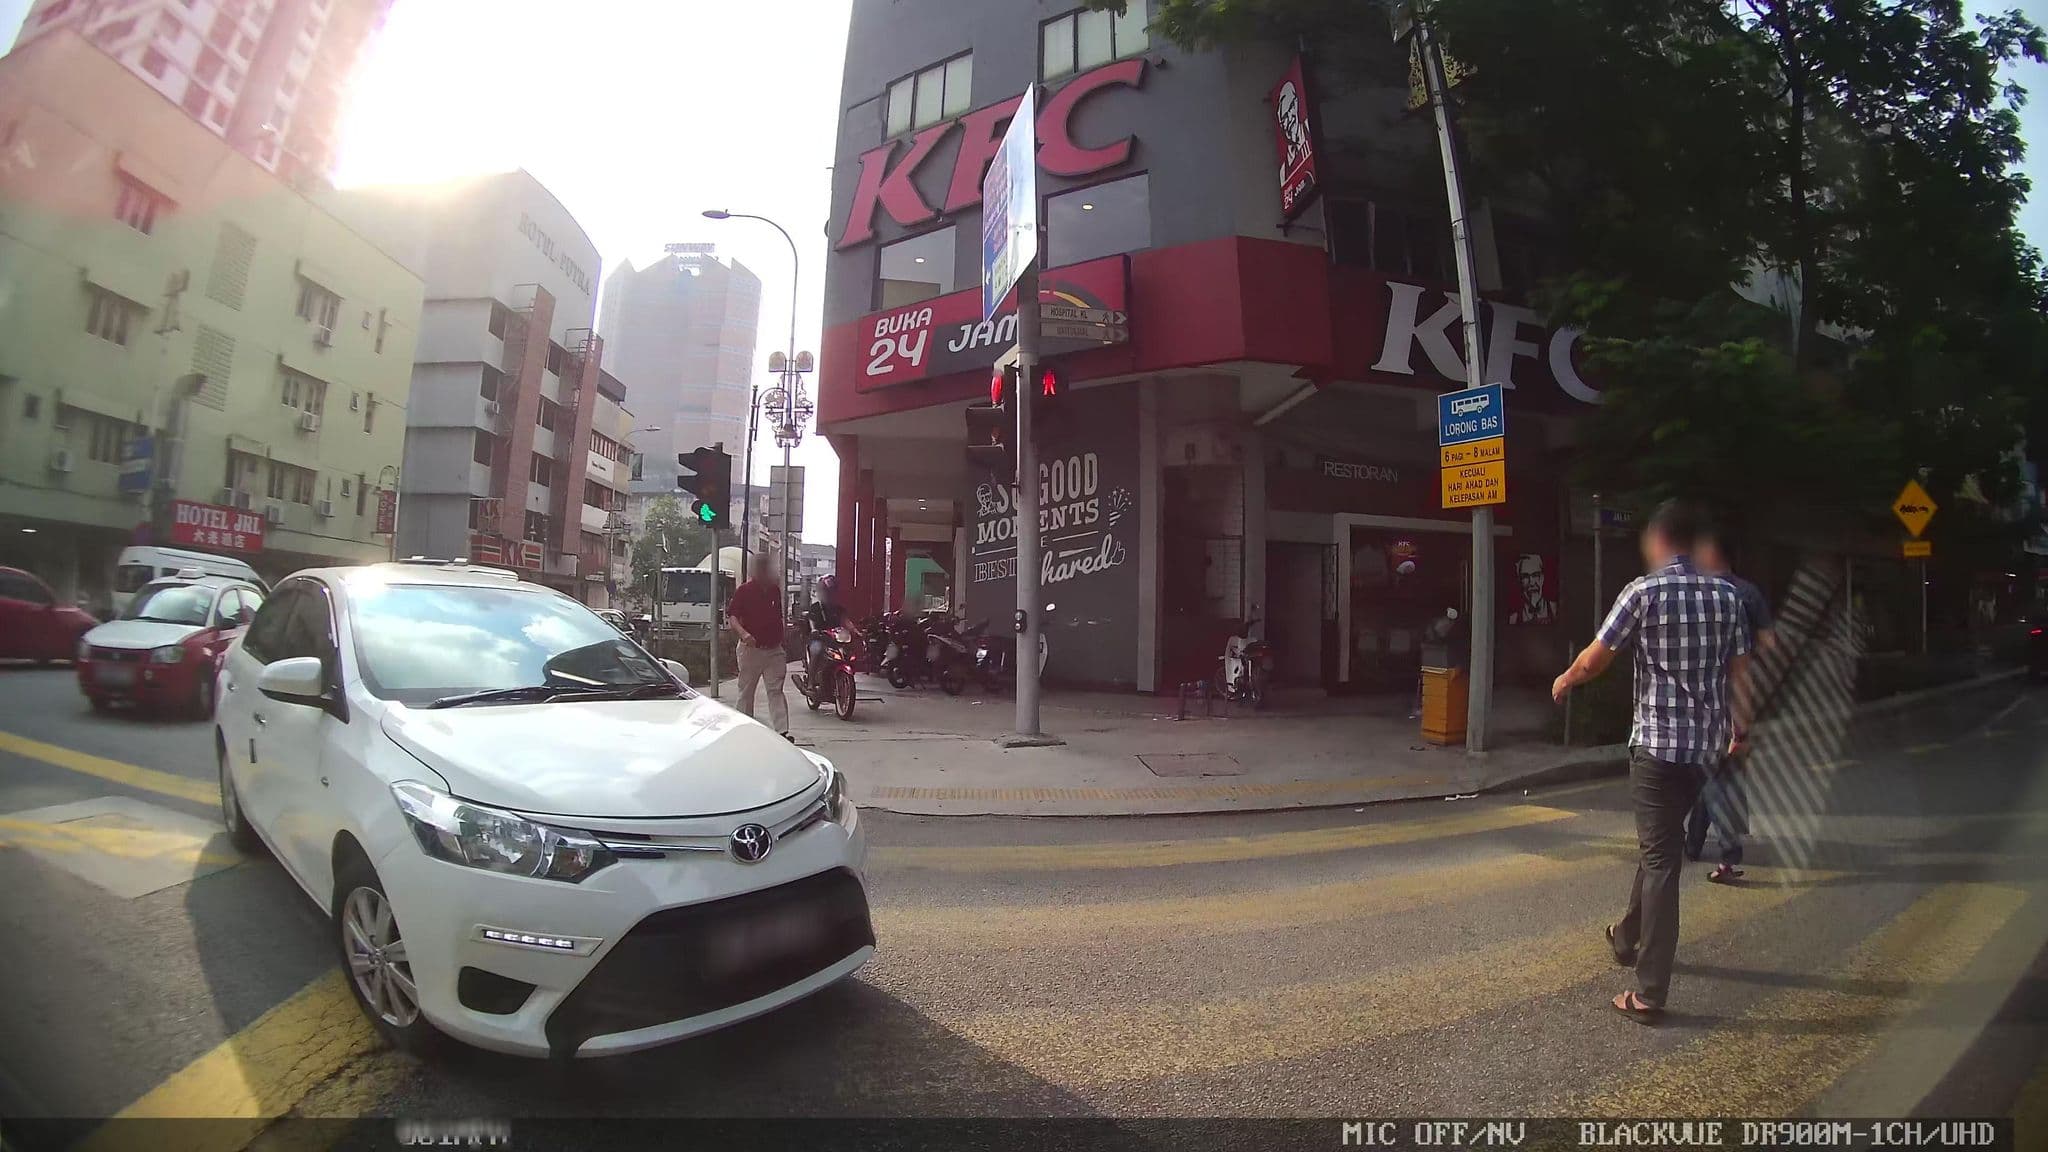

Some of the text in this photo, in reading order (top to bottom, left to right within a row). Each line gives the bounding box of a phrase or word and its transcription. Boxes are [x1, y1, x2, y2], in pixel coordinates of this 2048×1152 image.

[834, 58, 1145, 251] KFC
[874, 307, 933, 338] BUKA
[1051, 306, 1077, 318] HOSPITAL
[866, 313, 1018, 376] 24 JAM
[1370, 281, 1605, 405] KFC
[1445, 416, 1498, 436] LORONG BAS
[1445, 451, 1450, 462] 6
[1451, 452, 1463, 461] PAGI
[1473, 447, 1478, 457] 8
[1480, 447, 1500, 457] MALAM
[1324, 461, 1399, 482] RESTORAN
[1460, 467, 1486, 478] KECUALI
[1448, 478, 1499, 492] HARI AHAD DAN
[1449, 490, 1498, 503] KELEPASAN AM
[176, 503, 229, 530] HOTEL
[976, 498, 1099, 545] MOENTS
[1040, 533, 1113, 586] hared
